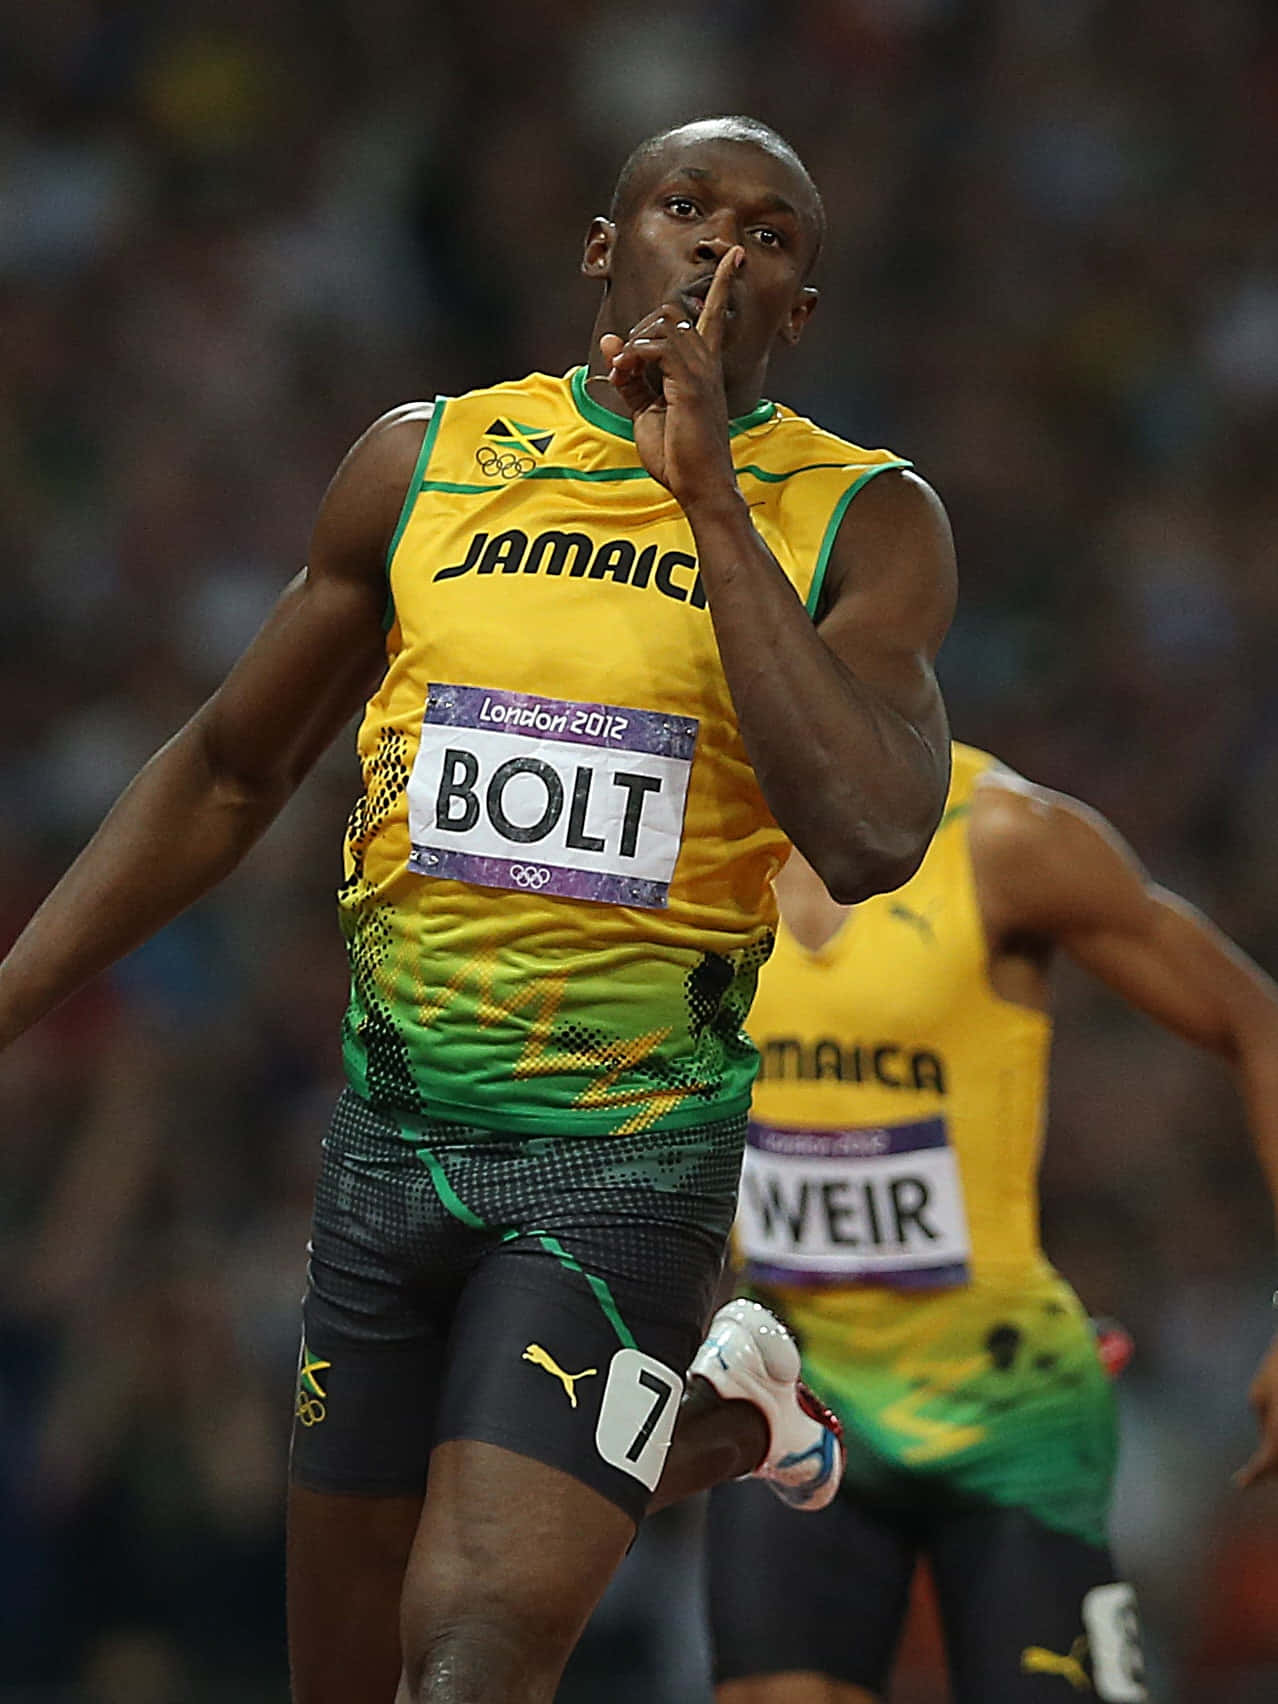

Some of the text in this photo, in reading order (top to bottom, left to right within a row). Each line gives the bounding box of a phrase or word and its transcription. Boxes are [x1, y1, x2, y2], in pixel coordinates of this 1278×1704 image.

[479, 697, 628, 741] London 2012
[435, 748, 662, 858] BOLT
[756, 1039, 945, 1095] MAICA
[747, 1175, 938, 1246] WEIR
[625, 1367, 673, 1464] 7
